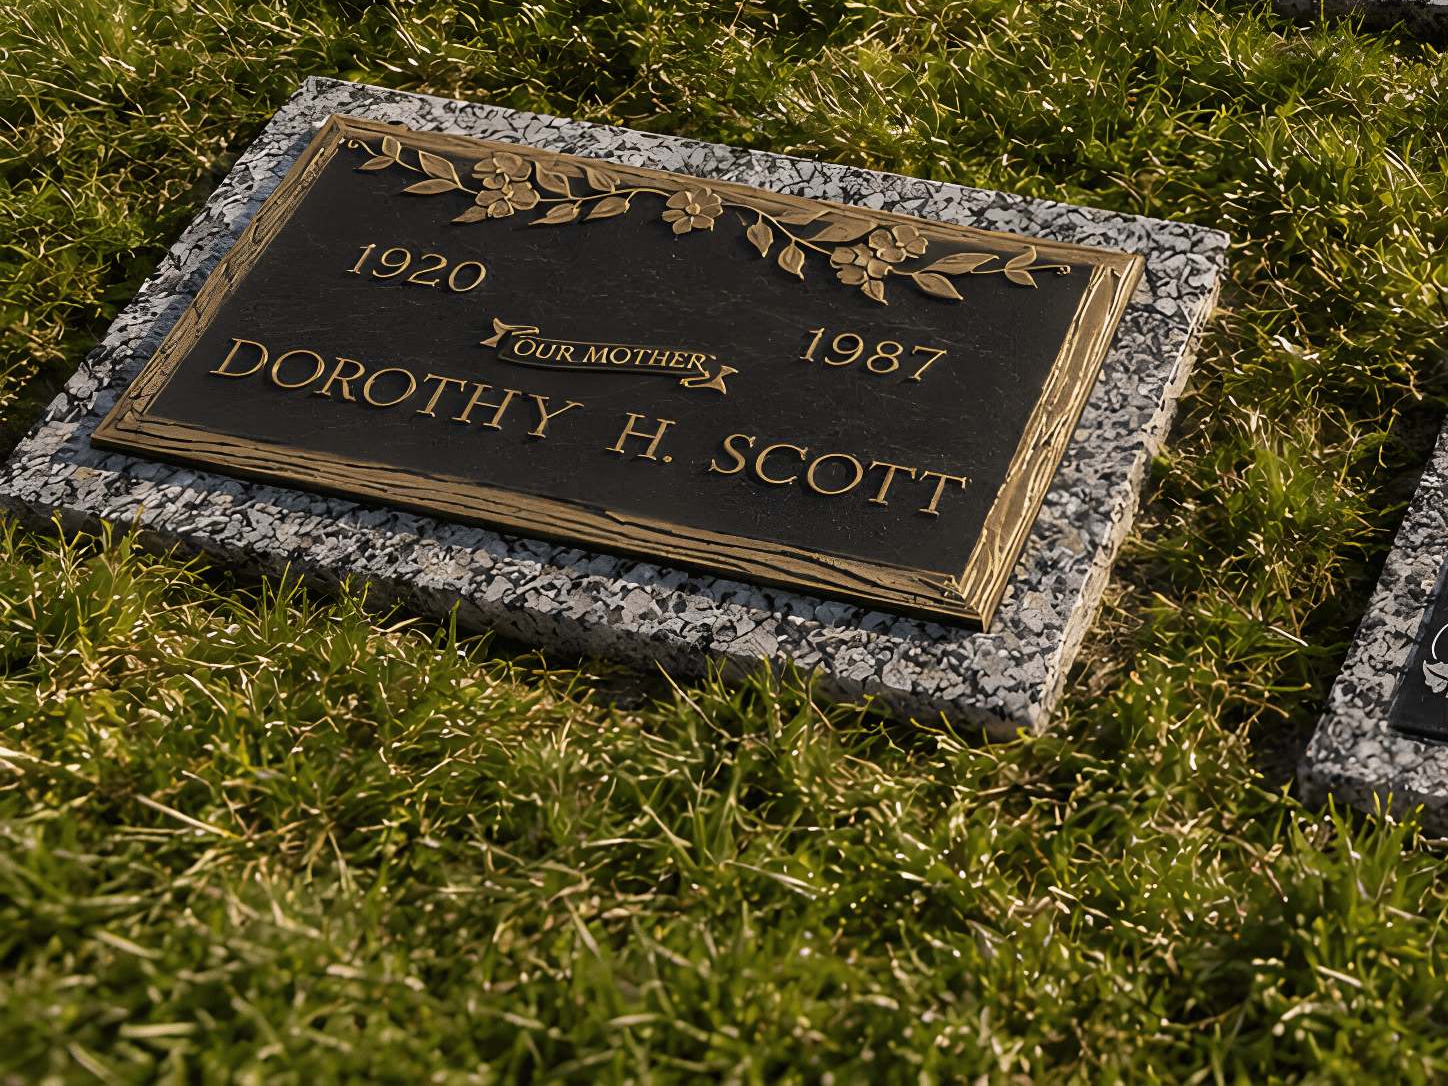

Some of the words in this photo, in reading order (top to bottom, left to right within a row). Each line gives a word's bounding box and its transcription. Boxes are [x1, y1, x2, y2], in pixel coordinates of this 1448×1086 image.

[346, 242, 488, 294] 1920
[513, 338, 575, 363] OUR
[582, 346, 709, 376] MOTHER
[797, 327, 948, 383] 1987
[209, 337, 585, 440] DOROTHY
[606, 411, 674, 464] H.
[708, 433, 969, 517] SCOTT
